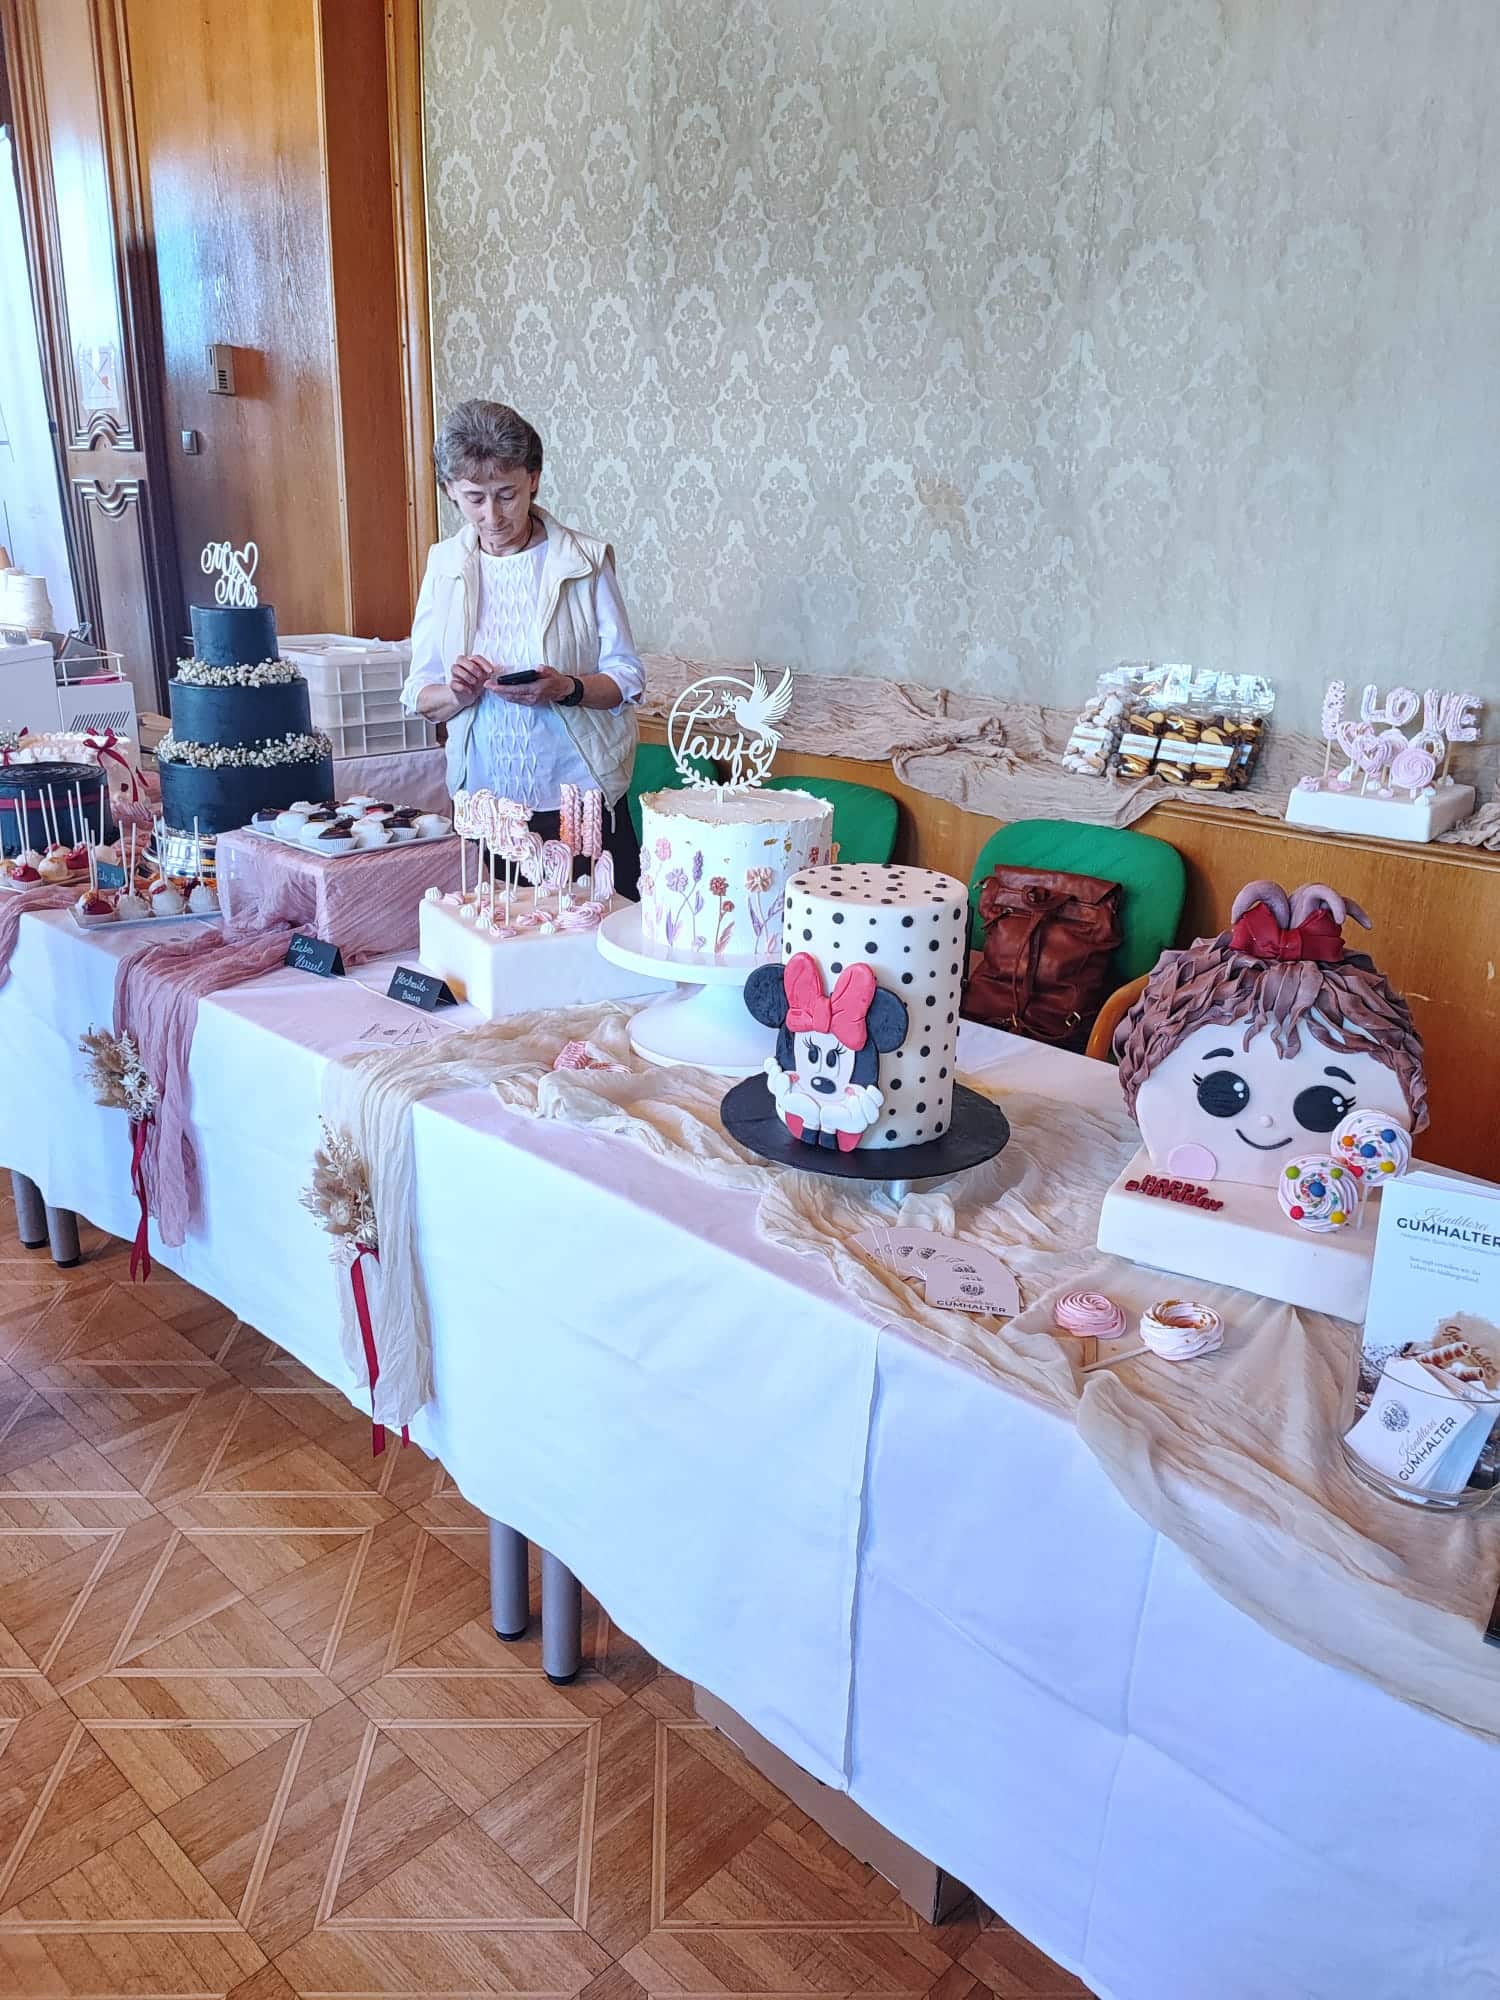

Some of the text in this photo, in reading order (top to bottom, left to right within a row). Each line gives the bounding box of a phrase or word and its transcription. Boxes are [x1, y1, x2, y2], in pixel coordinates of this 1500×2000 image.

[672, 712, 770, 786] Taufe
[936, 1300, 1006, 1313] GUMHALTER
[1398, 1416, 1457, 1481] GUMHALTER
